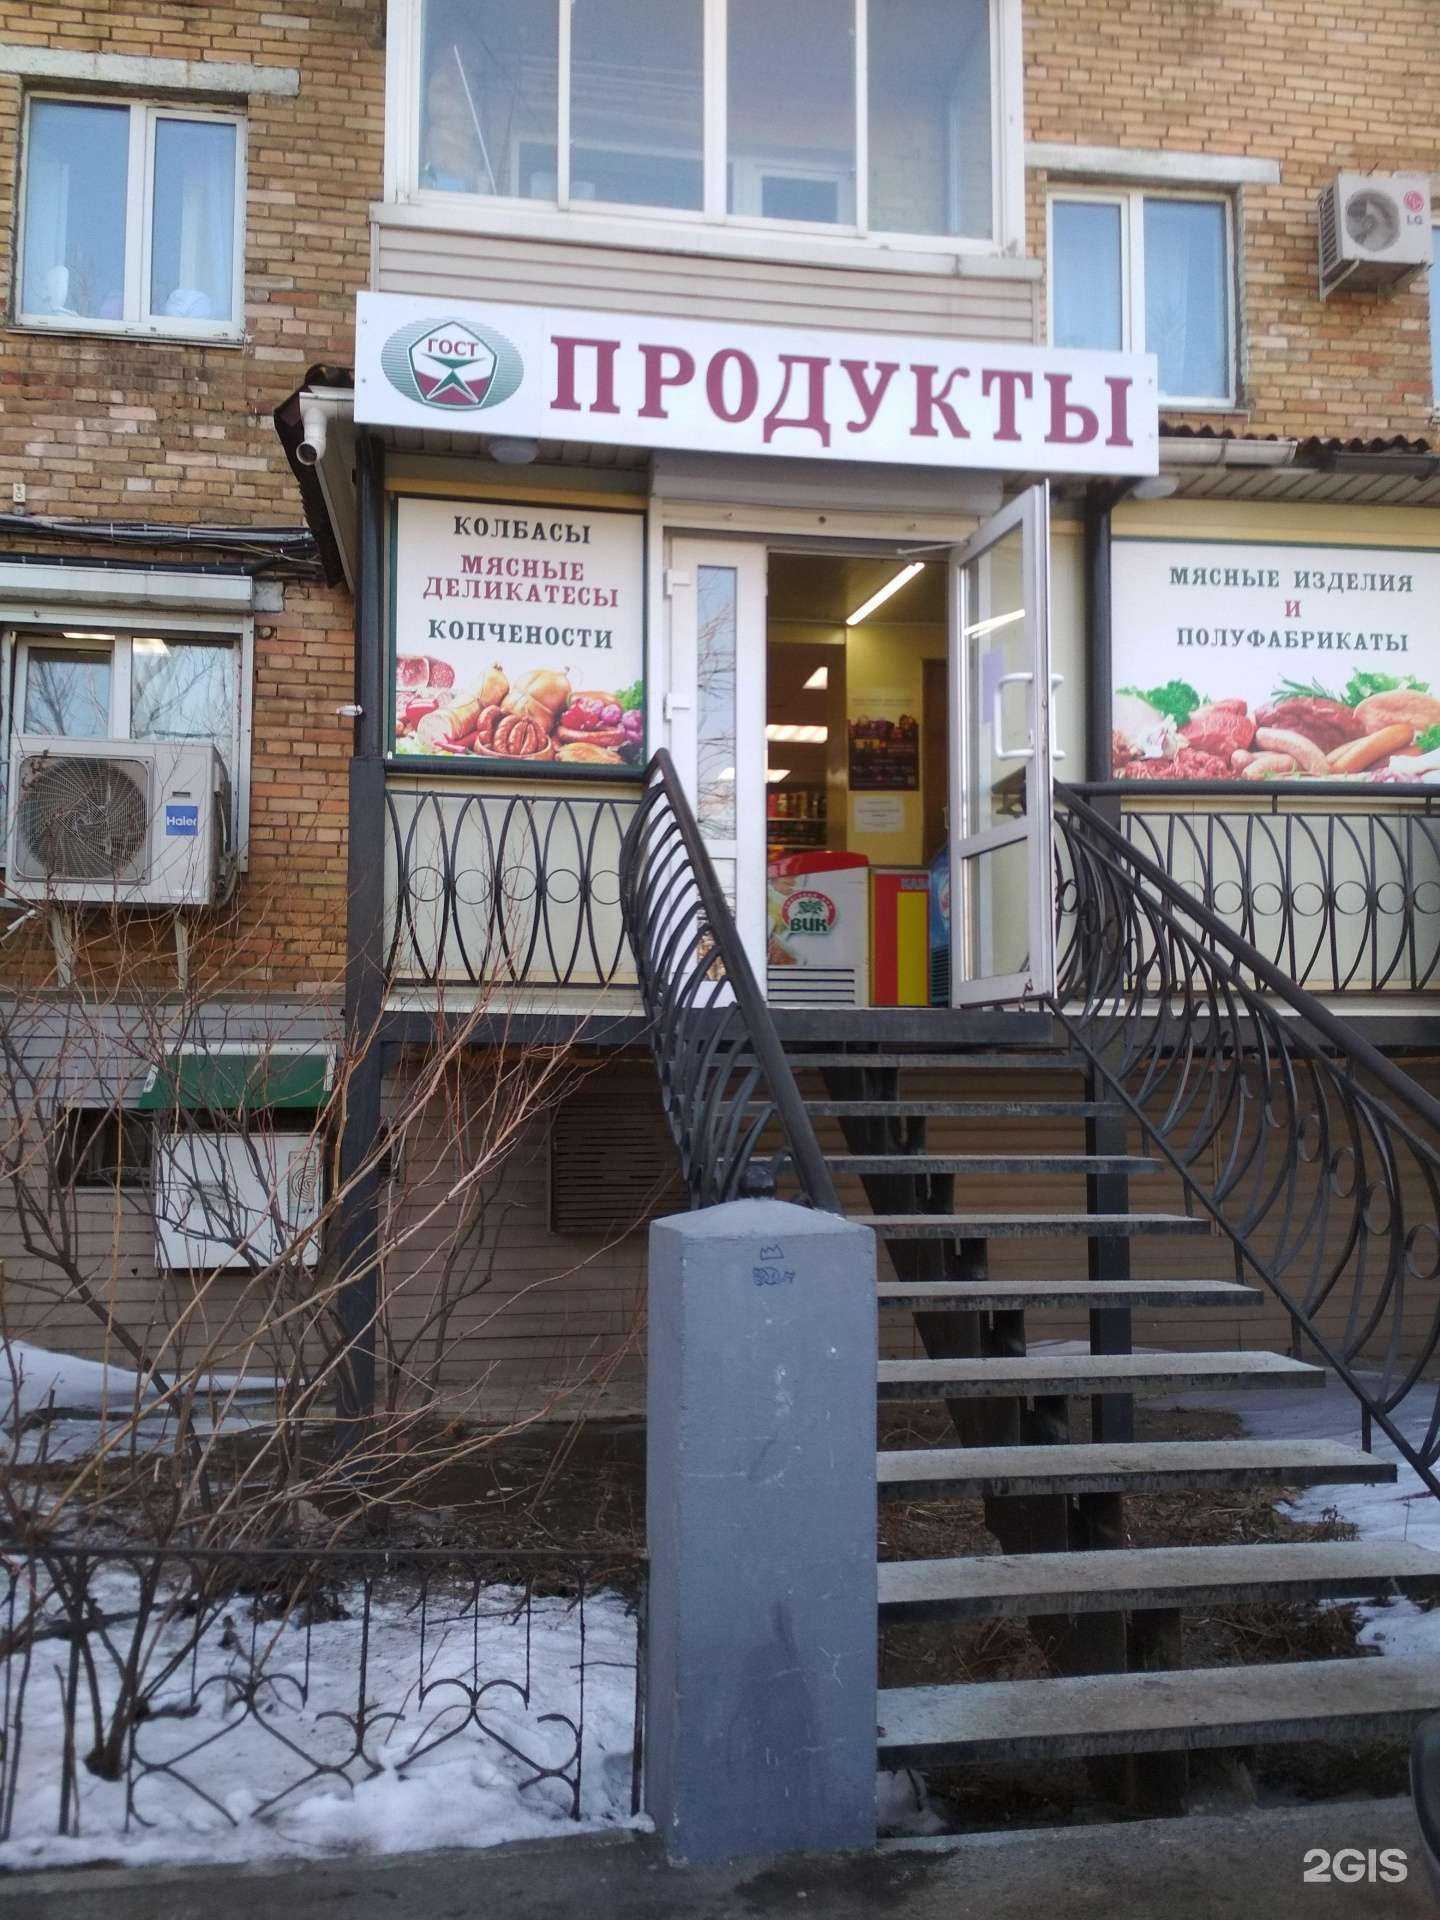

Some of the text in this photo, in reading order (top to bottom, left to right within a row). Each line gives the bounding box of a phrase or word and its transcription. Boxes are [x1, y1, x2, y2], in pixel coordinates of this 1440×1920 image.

[1406, 214, 1423, 225] LG
[427, 338, 479, 357] ГОСТ
[549, 335, 1134, 448] ПРОДУКТЫ
[453, 515, 591, 544] КОЛБАСЫ
[460, 554, 585, 582] МЯСНЫЕ
[1169, 566, 1414, 593] МЯСНЫЕ ИЗДЕЛИЯ
[423, 576, 619, 608] ДЕЛИКАТЕСЫ
[1284, 600, 1302, 618] И
[427, 618, 614, 650] КОПЧЕНОСТИ
[1176, 627, 1409, 652] ПОЛУФАБРИКАТЫ
[166, 815, 198, 827] Haier
